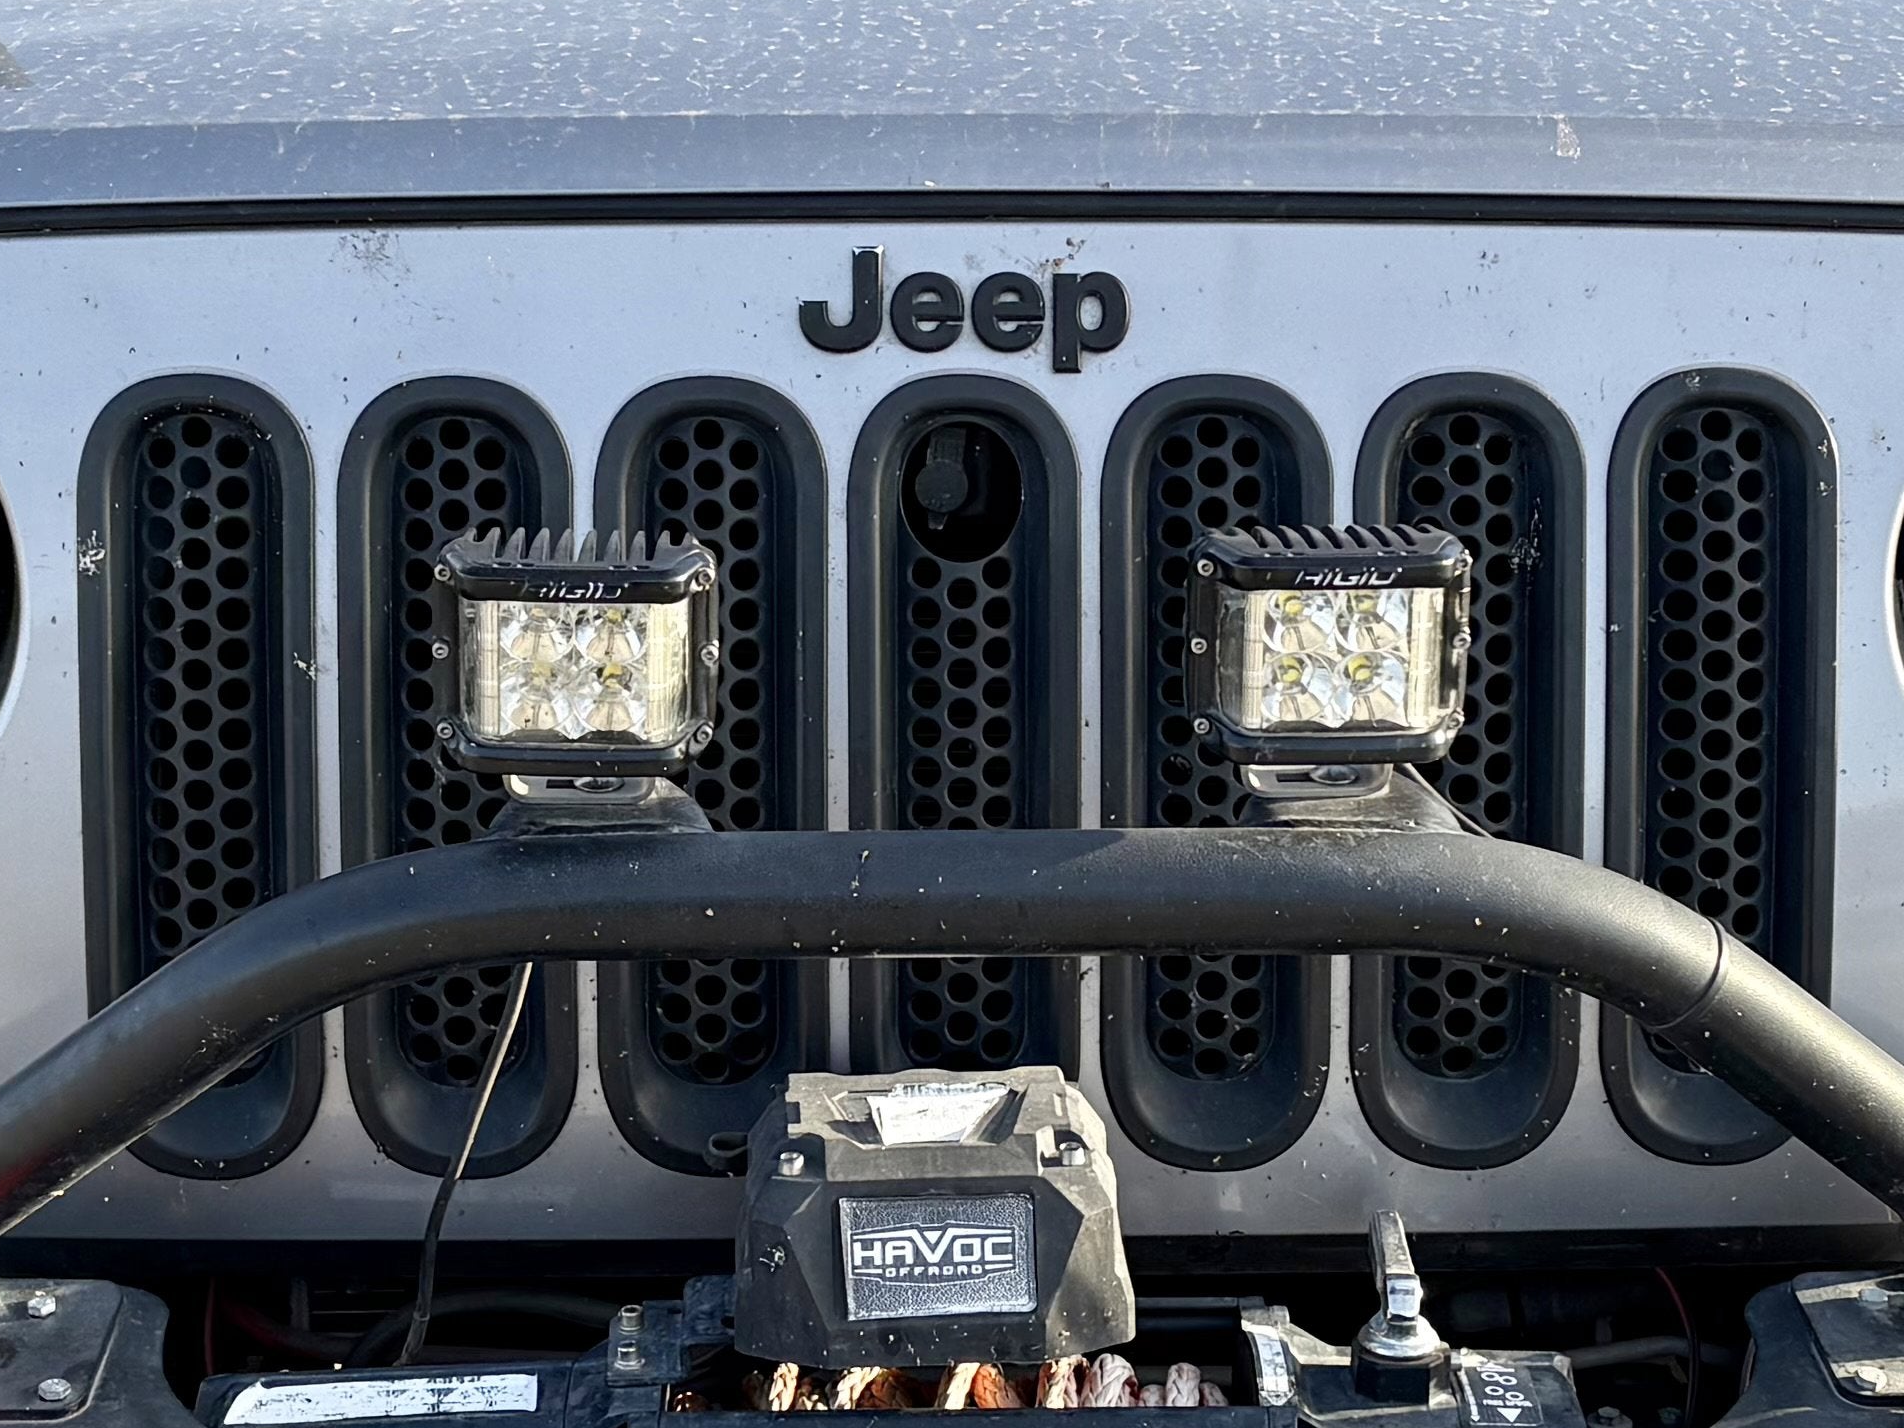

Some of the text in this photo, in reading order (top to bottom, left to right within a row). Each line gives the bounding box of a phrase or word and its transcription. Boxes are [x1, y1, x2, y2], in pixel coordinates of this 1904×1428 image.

[798, 245, 1131, 374] Jeep
[852, 1227, 1014, 1267] HAVOC
[885, 1264, 983, 1278] OFFROAD
